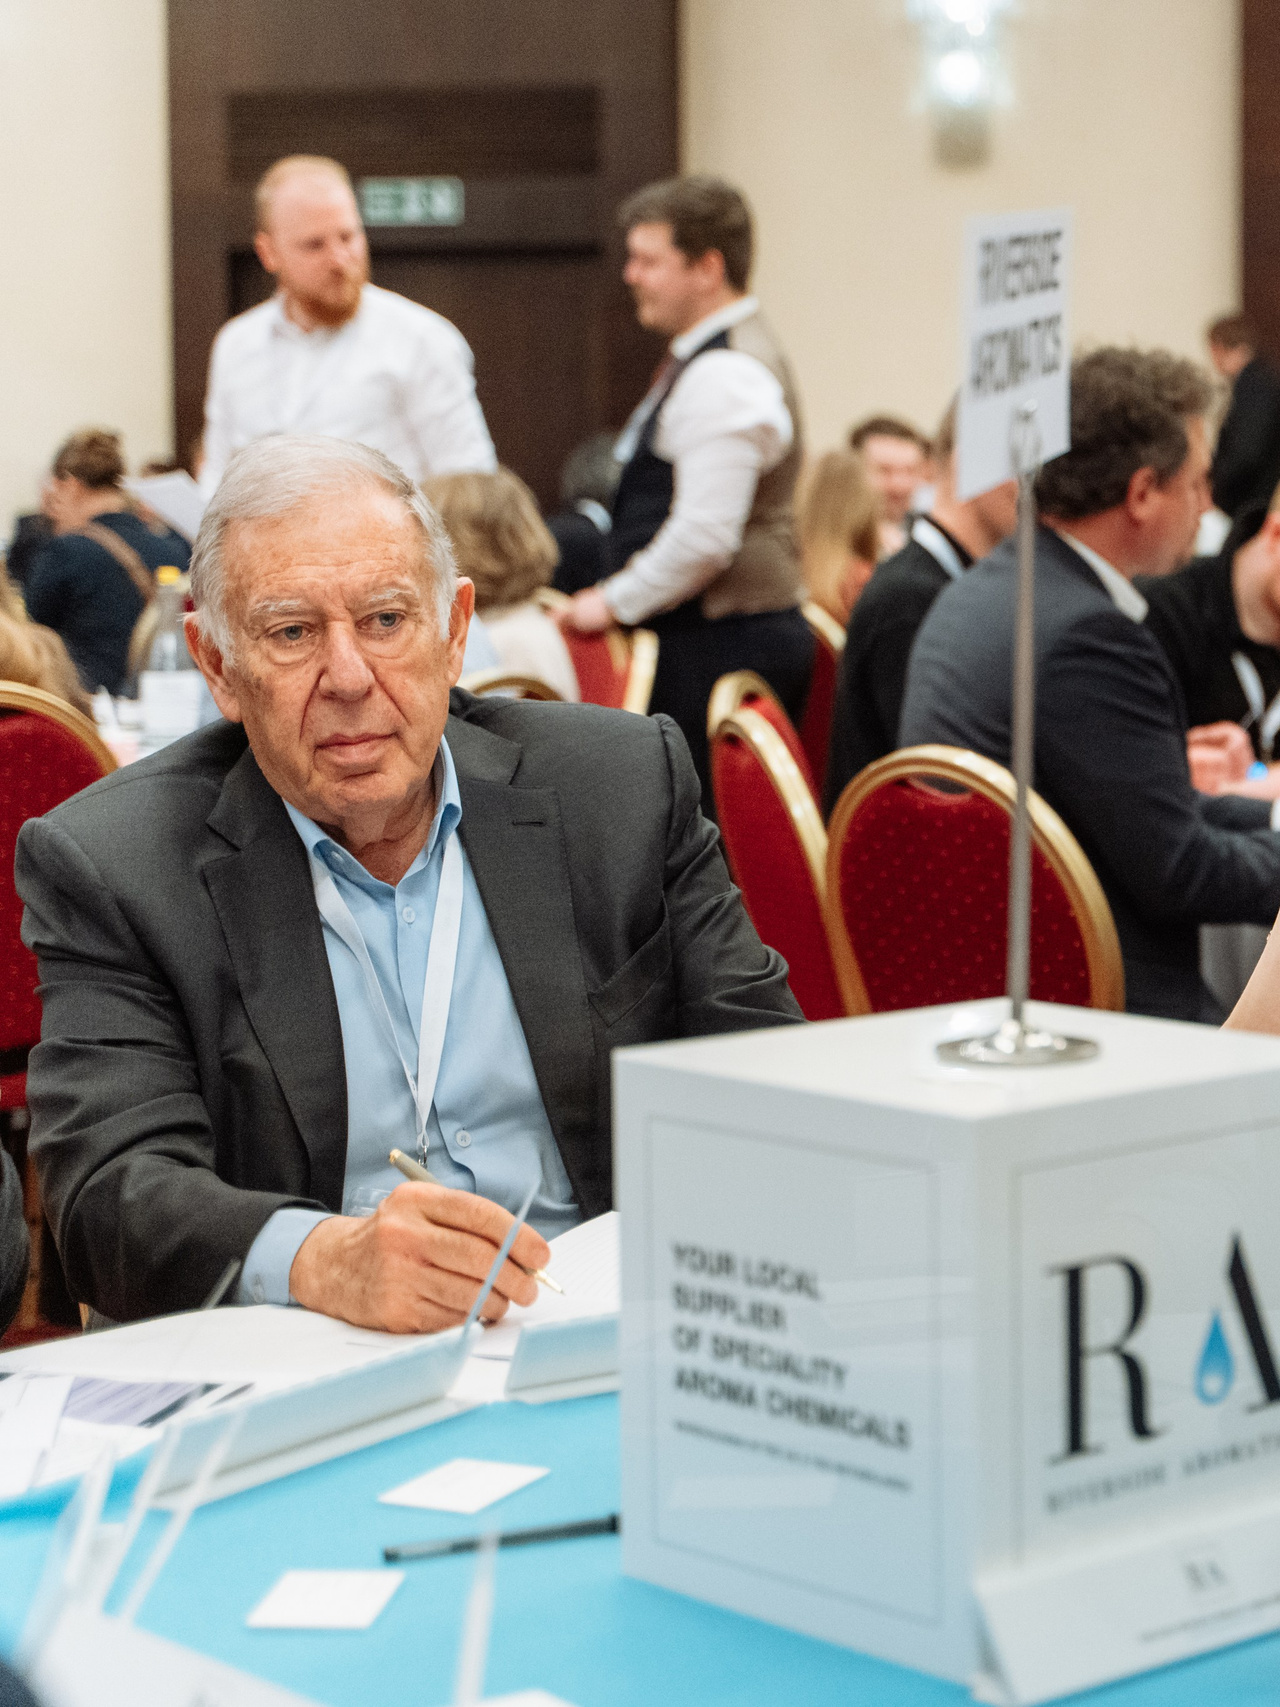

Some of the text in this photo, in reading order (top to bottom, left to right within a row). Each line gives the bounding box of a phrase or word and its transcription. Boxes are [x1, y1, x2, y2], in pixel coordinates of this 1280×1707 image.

[673, 1241, 822, 1301] YOUR LOCAL
[673, 1282, 787, 1333] SUPPLIER
[673, 1324, 847, 1390] OF SPECIALITY
[674, 1366, 912, 1452] AROMA CHEMICALS
